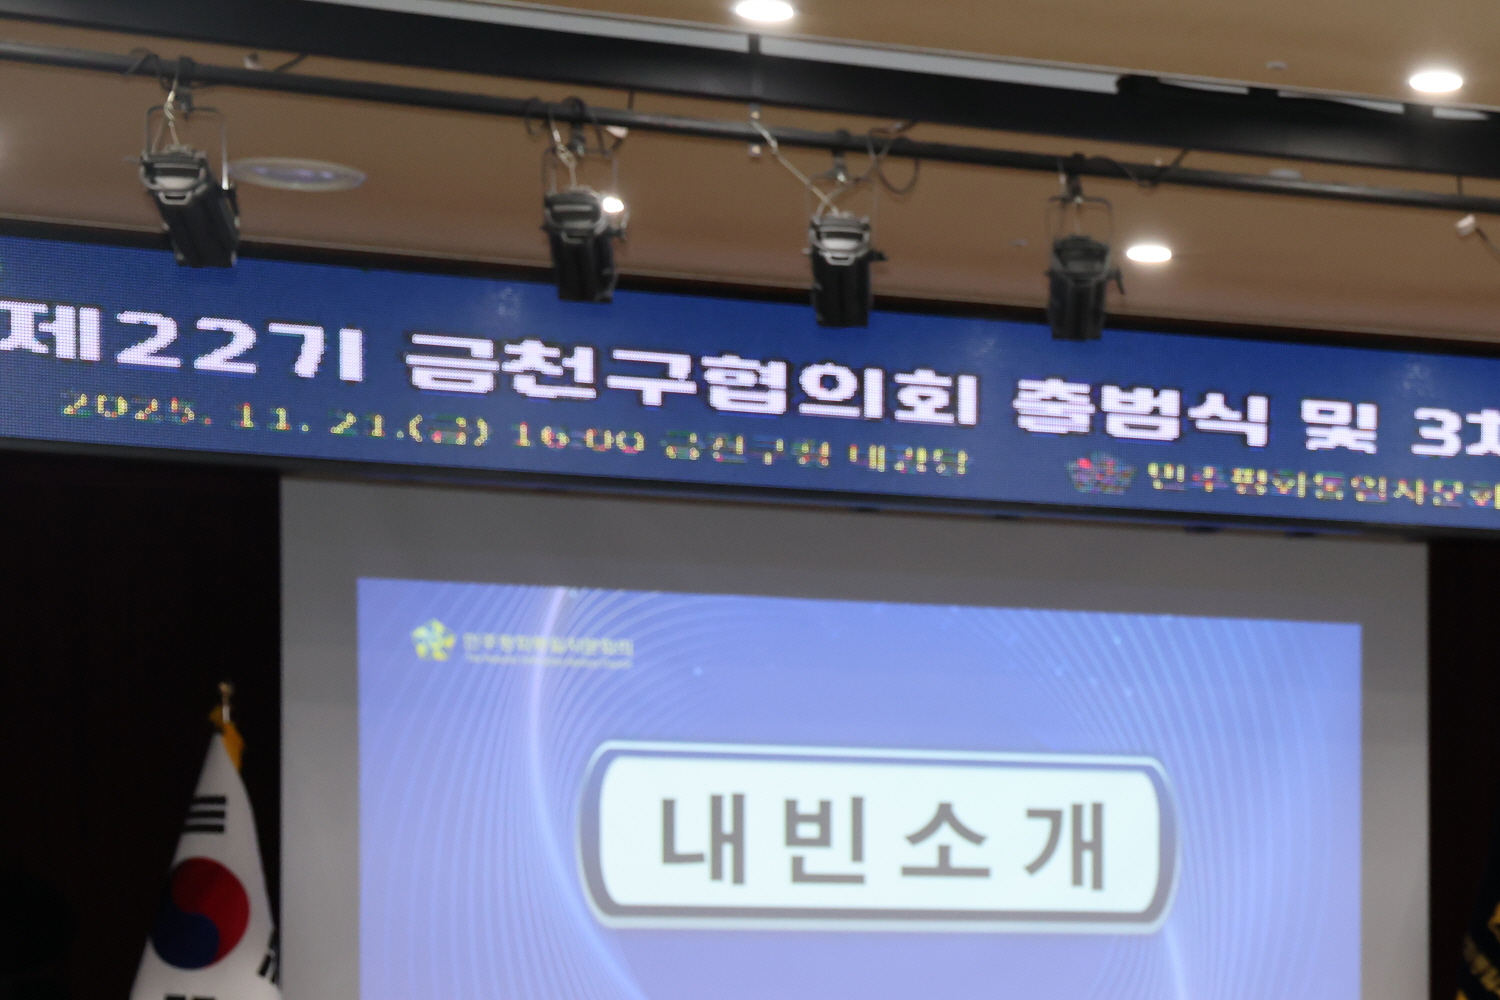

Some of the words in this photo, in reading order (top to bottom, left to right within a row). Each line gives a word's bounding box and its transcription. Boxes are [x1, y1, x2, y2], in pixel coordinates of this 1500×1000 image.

[0, 301, 364, 382] 제22기
[406, 333, 979, 426] 금천구협의회
[1012, 378, 1269, 447] 출범식
[1301, 399, 1378, 454] 및
